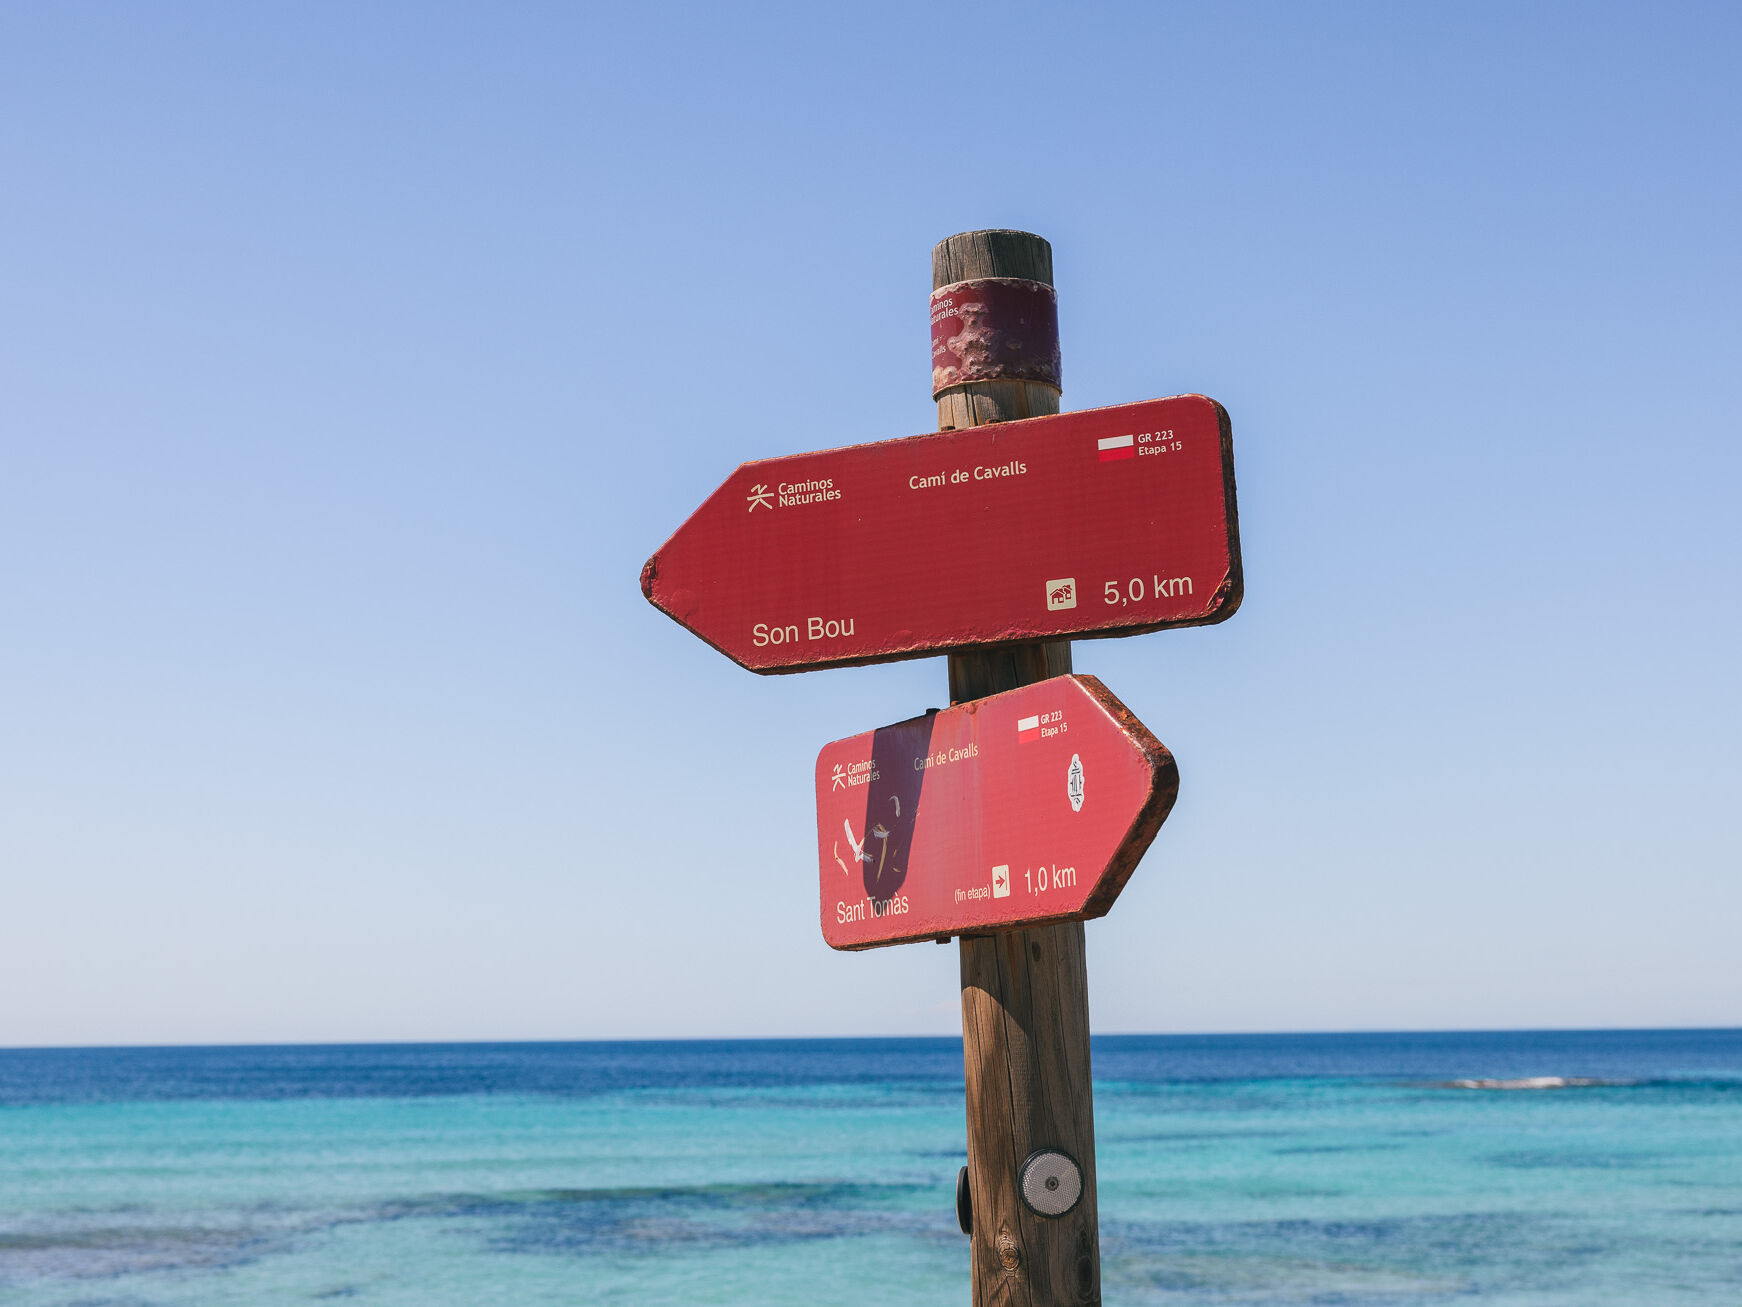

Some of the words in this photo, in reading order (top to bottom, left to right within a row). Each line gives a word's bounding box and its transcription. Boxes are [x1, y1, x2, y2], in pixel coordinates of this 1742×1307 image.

[1138, 433, 1153, 444] GR
[1155, 430, 1174, 441] 223
[1138, 445, 1167, 456] Etapa
[1170, 441, 1182, 451] 15
[909, 472, 946, 489] Camí
[950, 469, 970, 483] de
[974, 461, 1027, 480] Cavalls
[778, 479, 833, 495] Caminos
[779, 488, 841, 507] Naturales
[1104, 577, 1145, 606] 5,0
[1153, 574, 1193, 599] km
[752, 623, 799, 647] Son
[807, 616, 855, 640] Bou
[1040, 714, 1050, 724] GR
[1050, 710, 1063, 722] 223
[1041, 726, 1059, 738] Etapa
[1059, 723, 1068, 733] 15
[847, 758, 876, 775] Caminos
[914, 753, 934, 771] Camí
[936, 751, 947, 766] de
[948, 743, 979, 762] Cavalls
[847, 769, 881, 787] Naturales
[1024, 866, 1048, 896] 1,0
[1052, 864, 1077, 889] km
[954, 889, 968, 904] (fin
[967, 885, 991, 901] etapa)
[836, 899, 866, 924] Sant
[866, 892, 909, 919] Tomàs
